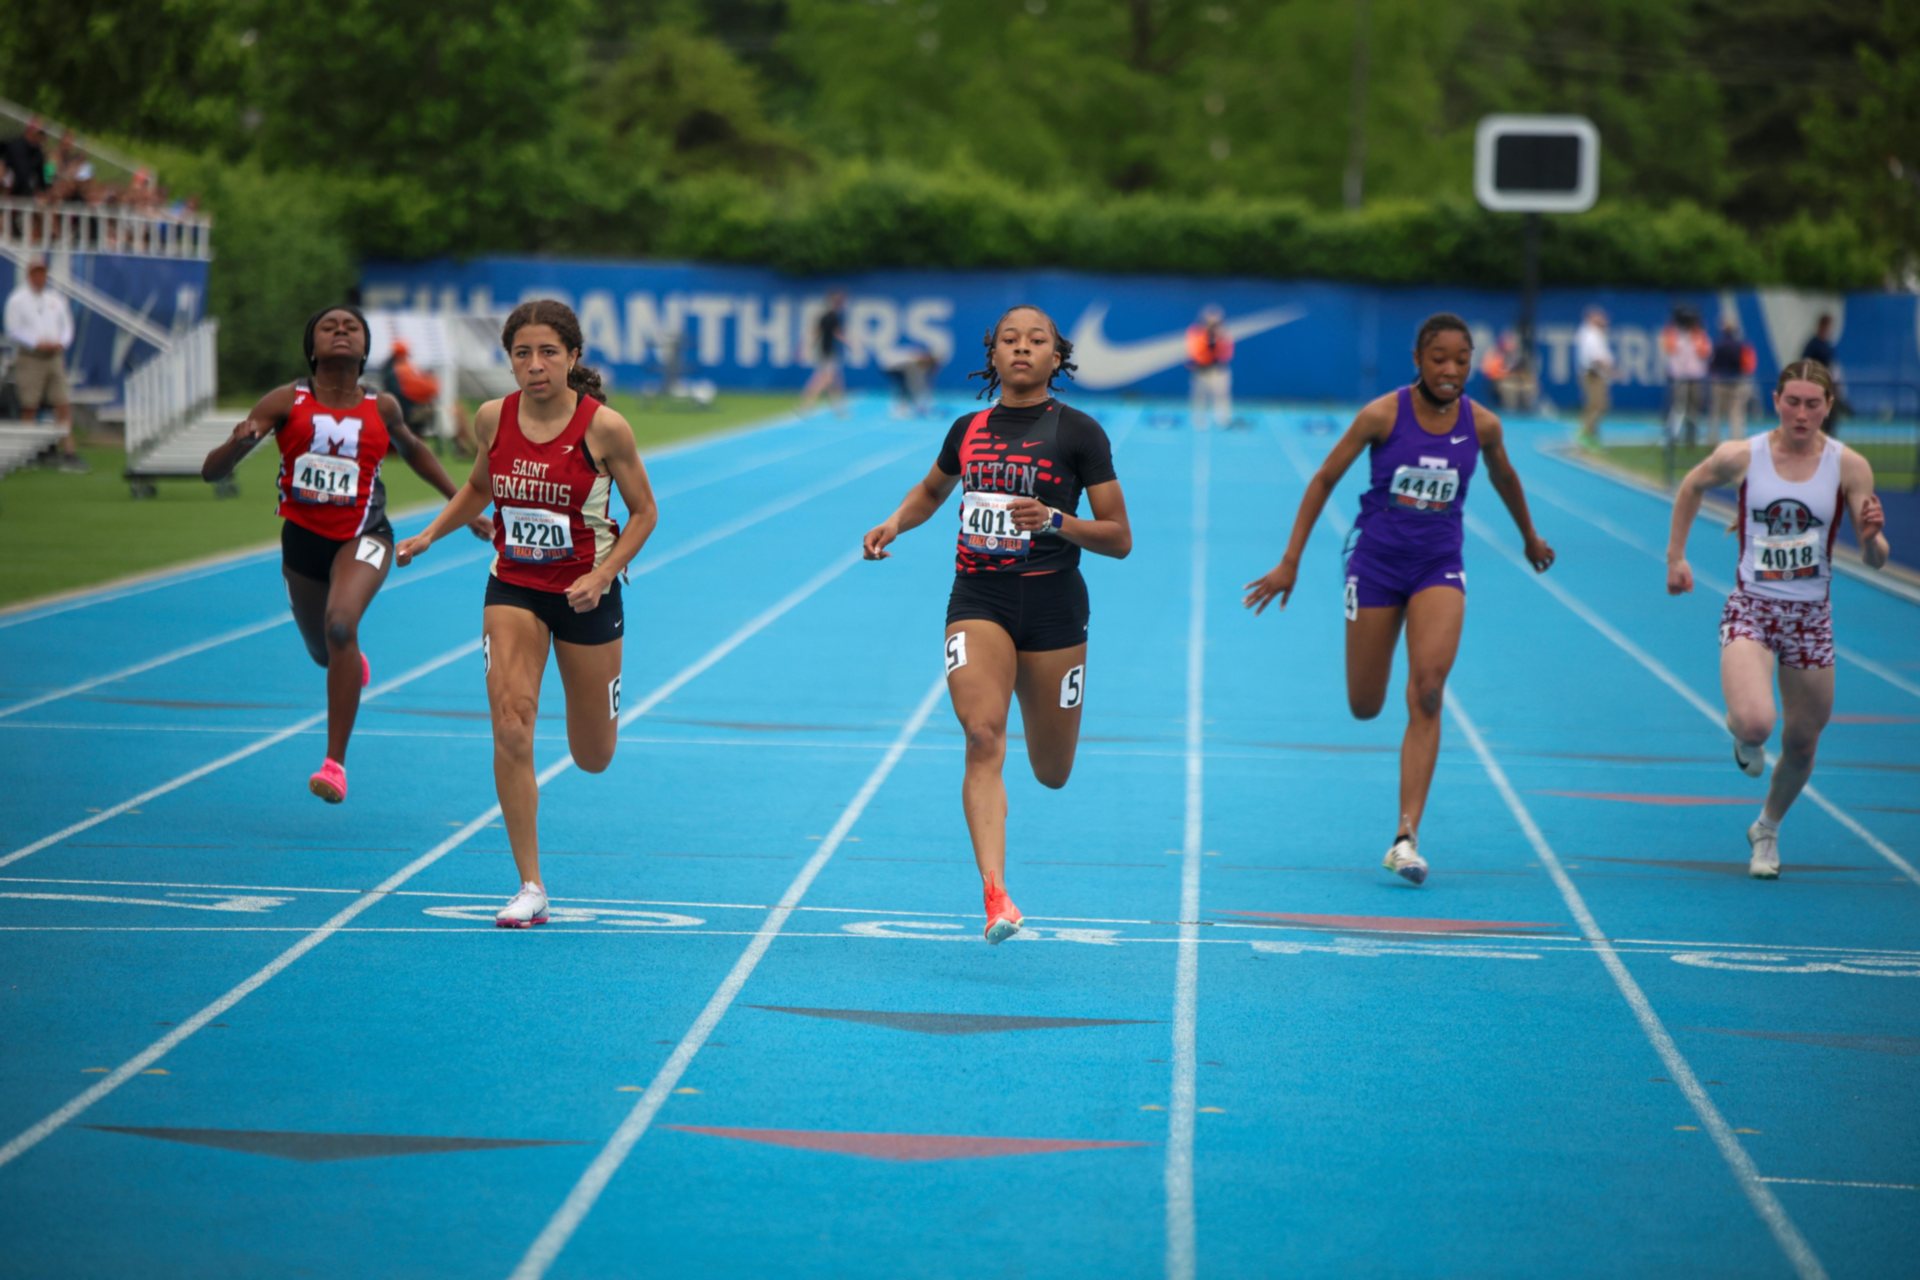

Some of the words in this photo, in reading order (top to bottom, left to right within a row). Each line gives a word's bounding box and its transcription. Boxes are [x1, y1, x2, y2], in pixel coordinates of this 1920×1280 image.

[518, 286, 954, 368] ANTHERS
[311, 414, 363, 458] M
[300, 466, 350, 494] 4614
[511, 458, 549, 479] SAINT
[964, 461, 1038, 495] ALTON
[492, 473, 572, 507] IGNATIUS
[1398, 478, 1453, 501] 4446
[512, 521, 565, 547] 4220
[968, 508, 1023, 537] 401
[363, 540, 381, 560] 7
[1761, 546, 1812, 569] 4018
[612, 677, 621, 713] 6
[1067, 668, 1080, 706] 5
